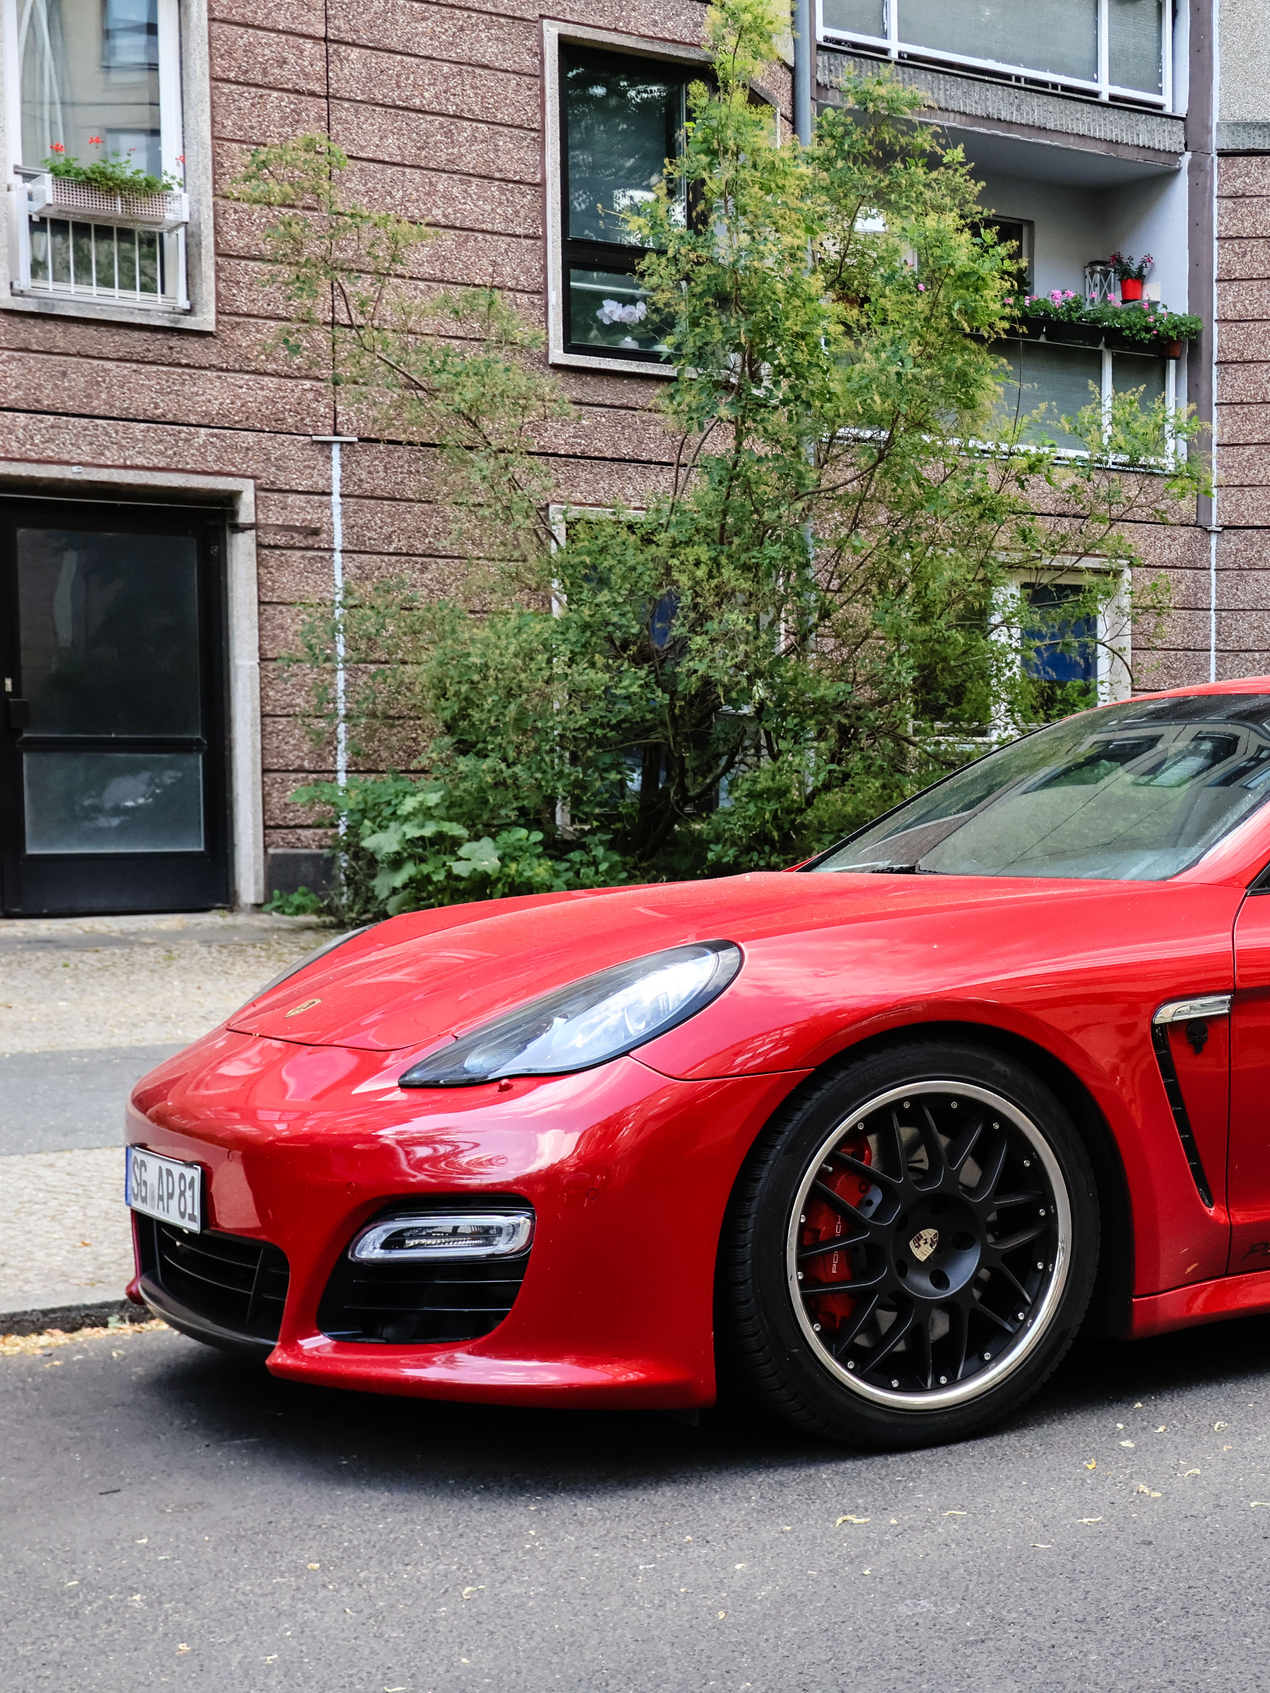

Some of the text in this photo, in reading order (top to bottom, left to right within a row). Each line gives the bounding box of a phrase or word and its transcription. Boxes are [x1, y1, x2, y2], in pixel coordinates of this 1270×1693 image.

[132, 1156, 197, 1223] SG AP 81
